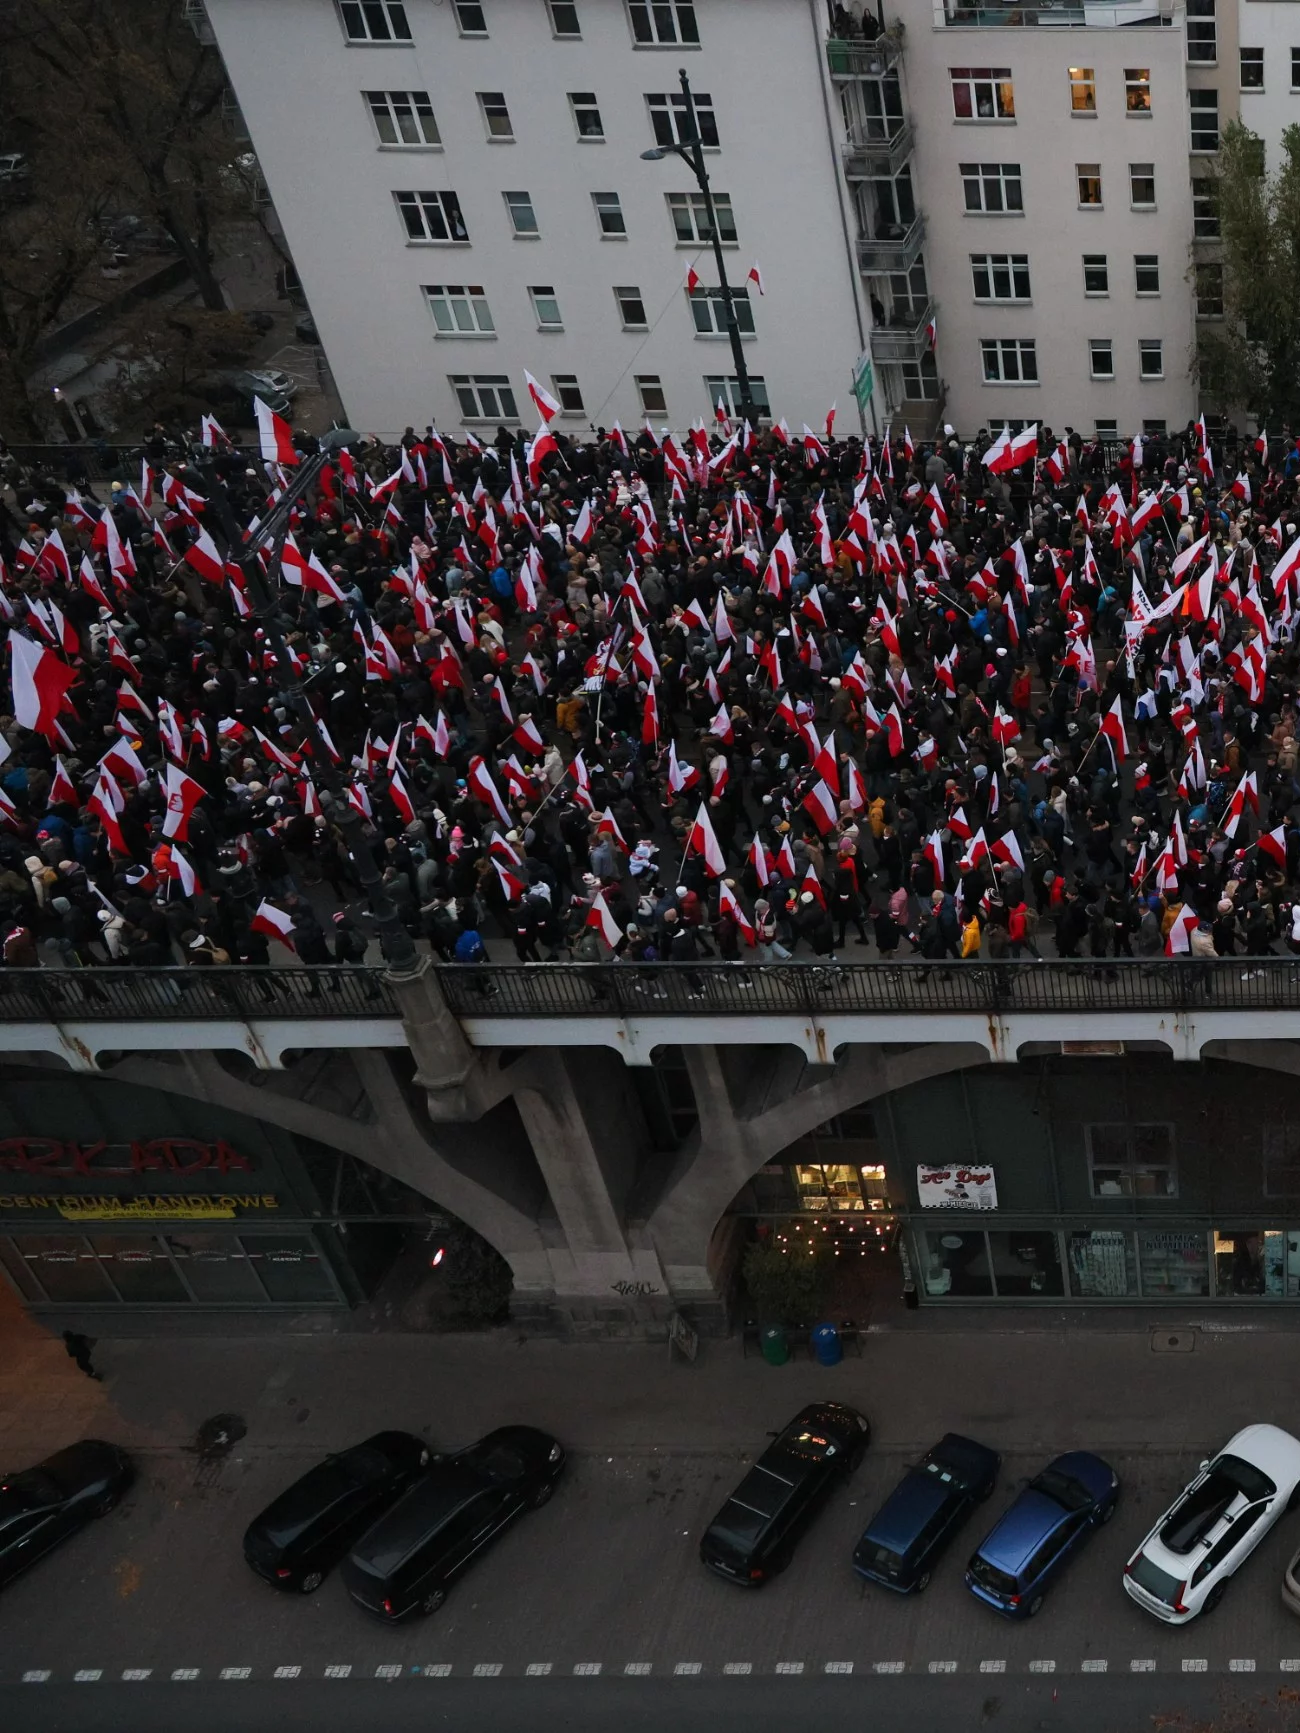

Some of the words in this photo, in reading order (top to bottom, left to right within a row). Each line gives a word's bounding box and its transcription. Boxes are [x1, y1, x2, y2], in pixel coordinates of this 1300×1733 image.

[0, 1195, 123, 1210] CENTRUM
[132, 1195, 280, 1209] HANDLOWE
[1155, 1234, 1195, 1242] CHEMIA
